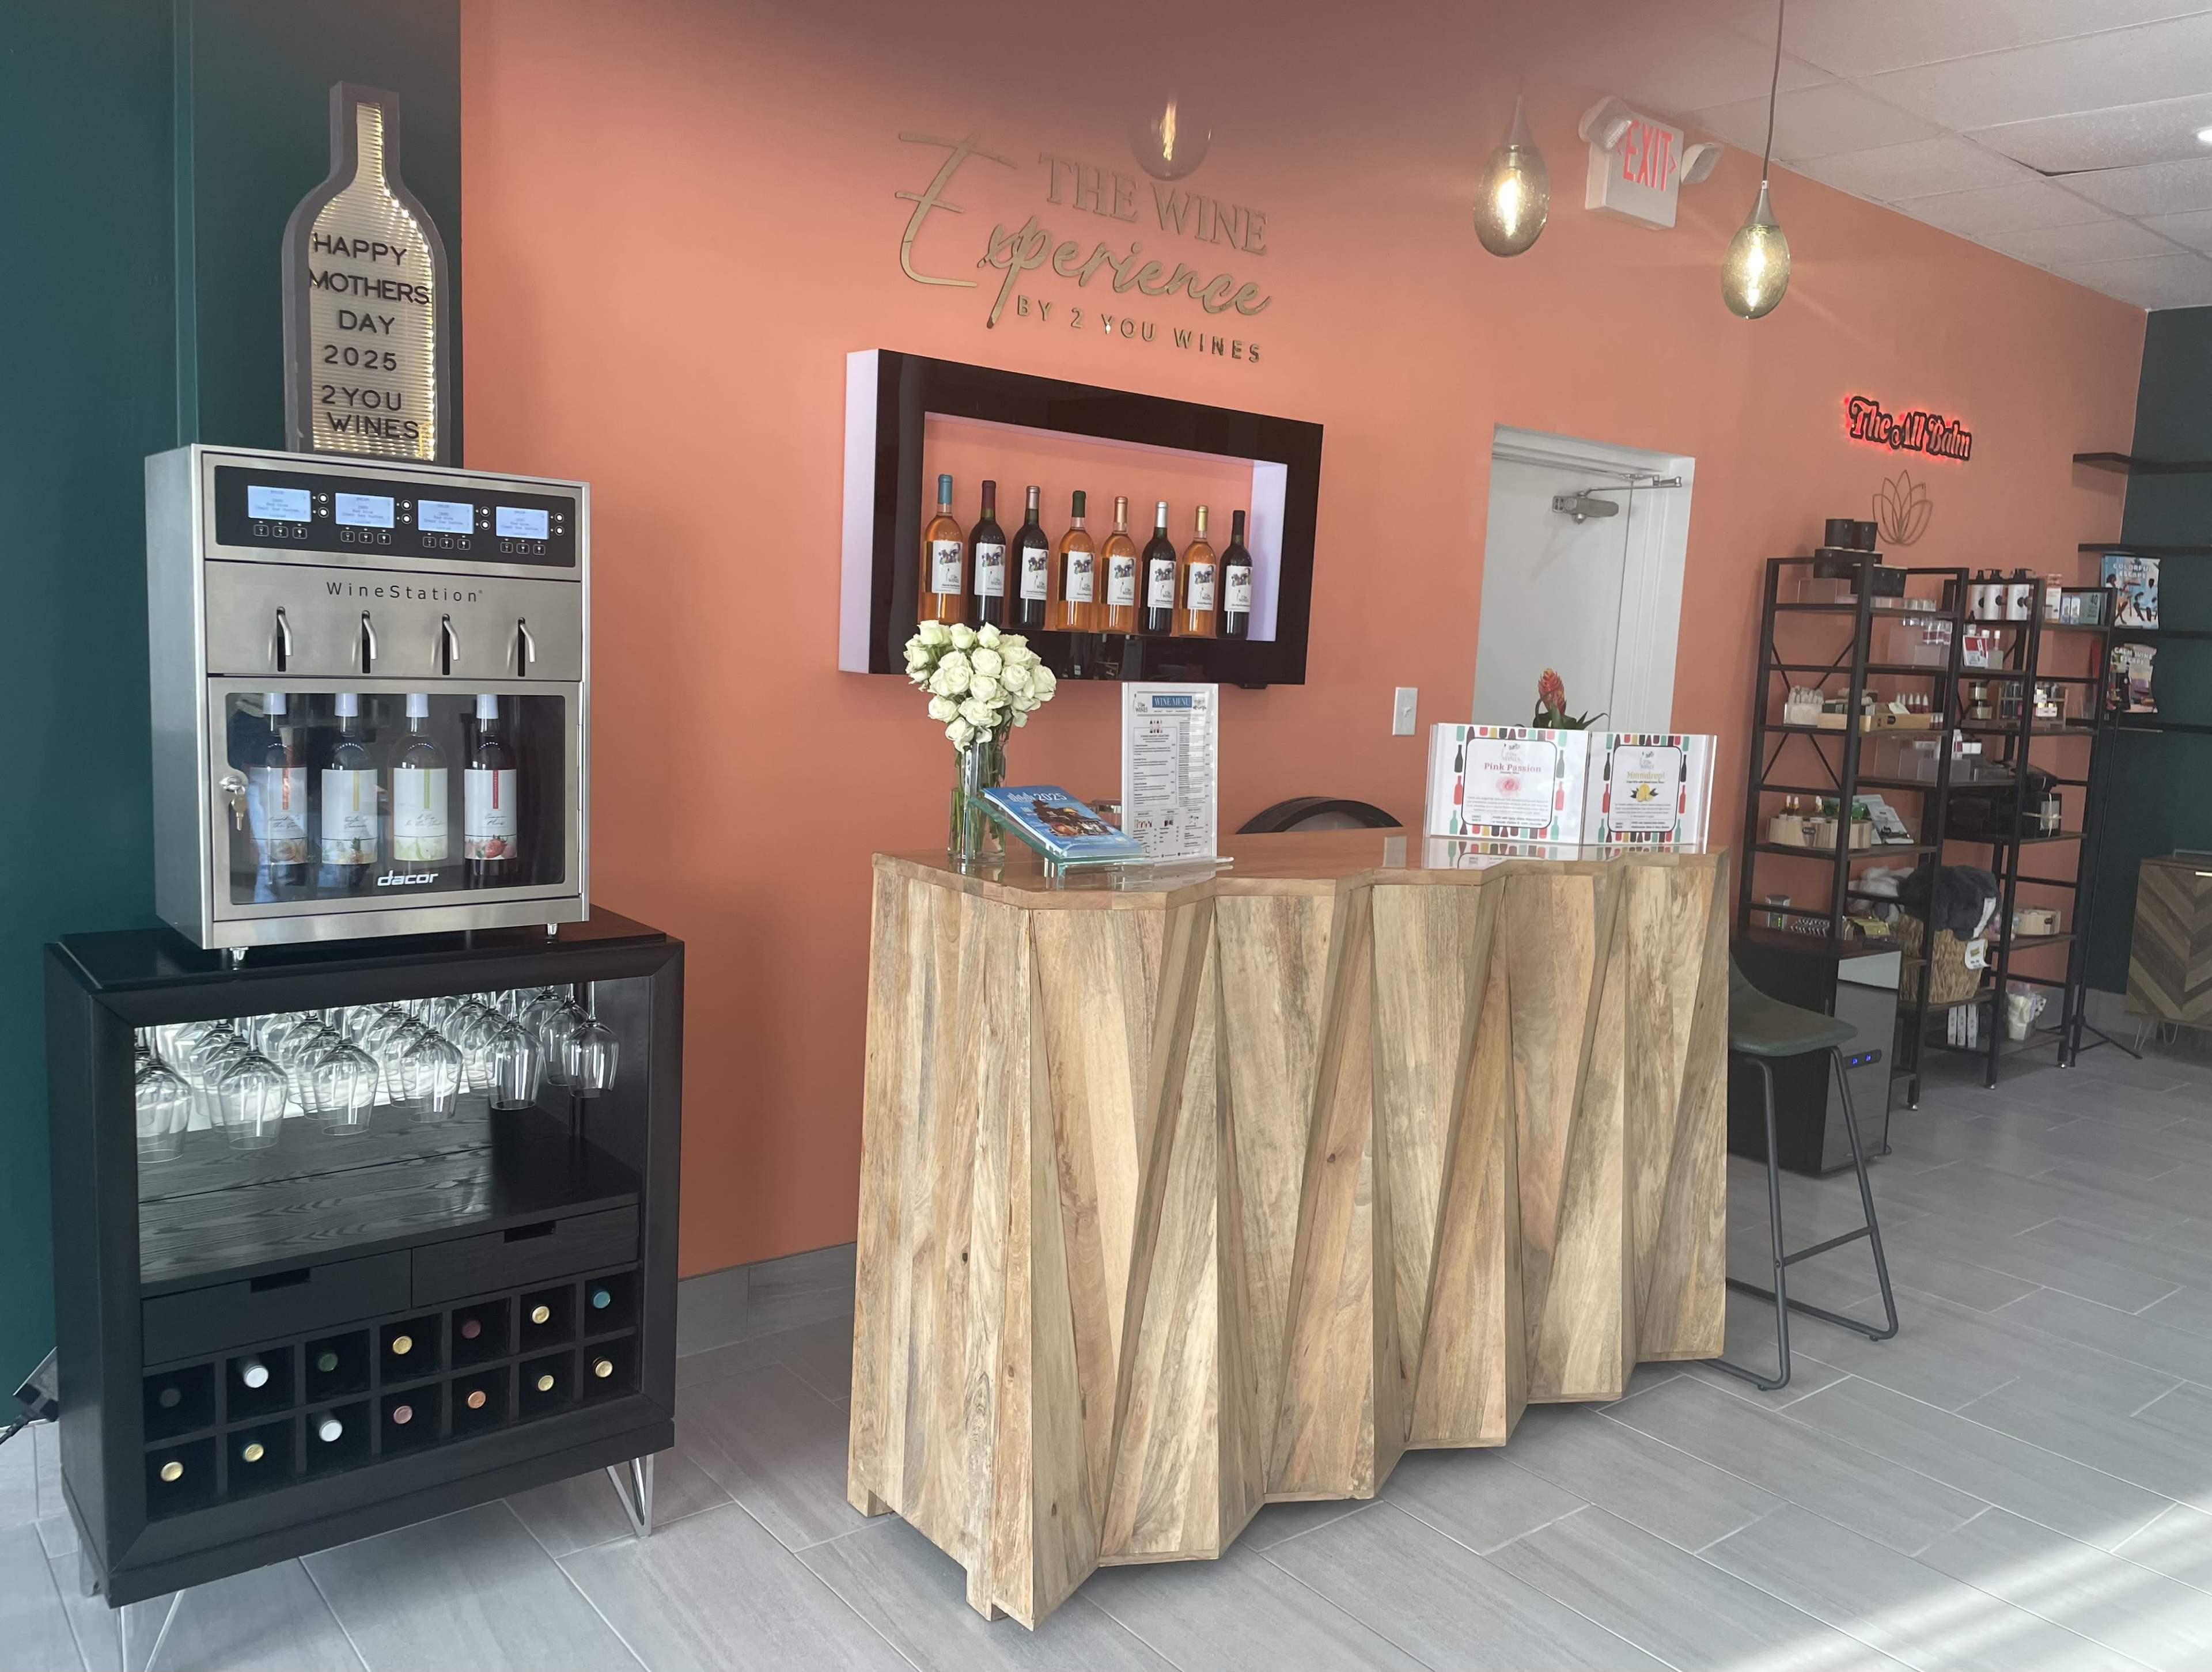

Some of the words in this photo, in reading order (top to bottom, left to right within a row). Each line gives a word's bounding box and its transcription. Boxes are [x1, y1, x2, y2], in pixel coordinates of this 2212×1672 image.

[1623, 119, 1673, 192] EXIT
[1039, 151, 1139, 222] THE
[1150, 181, 1267, 255] WINE
[895, 132, 1271, 329] Experience
[313, 233, 407, 266] HAPPY
[309, 269, 429, 305] MOTHERS
[339, 309, 395, 334] DAY
[1017, 295, 1051, 321] BY
[1071, 308, 1084, 328] 2
[1101, 314, 1156, 342] YOU
[1174, 327, 1260, 363] WINES
[324, 344, 397, 371] 2025
[327, 411, 419, 439] WINES
[2113, 563, 2152, 572] COLORFUL
[327, 582, 476, 602] WineStation
[2113, 647, 2133, 656] CALM
[2134, 650, 2153, 660] WINE
[1154, 697, 1172, 706] WINE
[1172, 697, 1190, 706] MENU
[1484, 762, 1505, 771] Pink
[1506, 764, 1541, 773] Passion
[1033, 793, 1067, 802] 2025
[377, 870, 438, 887] dacor
